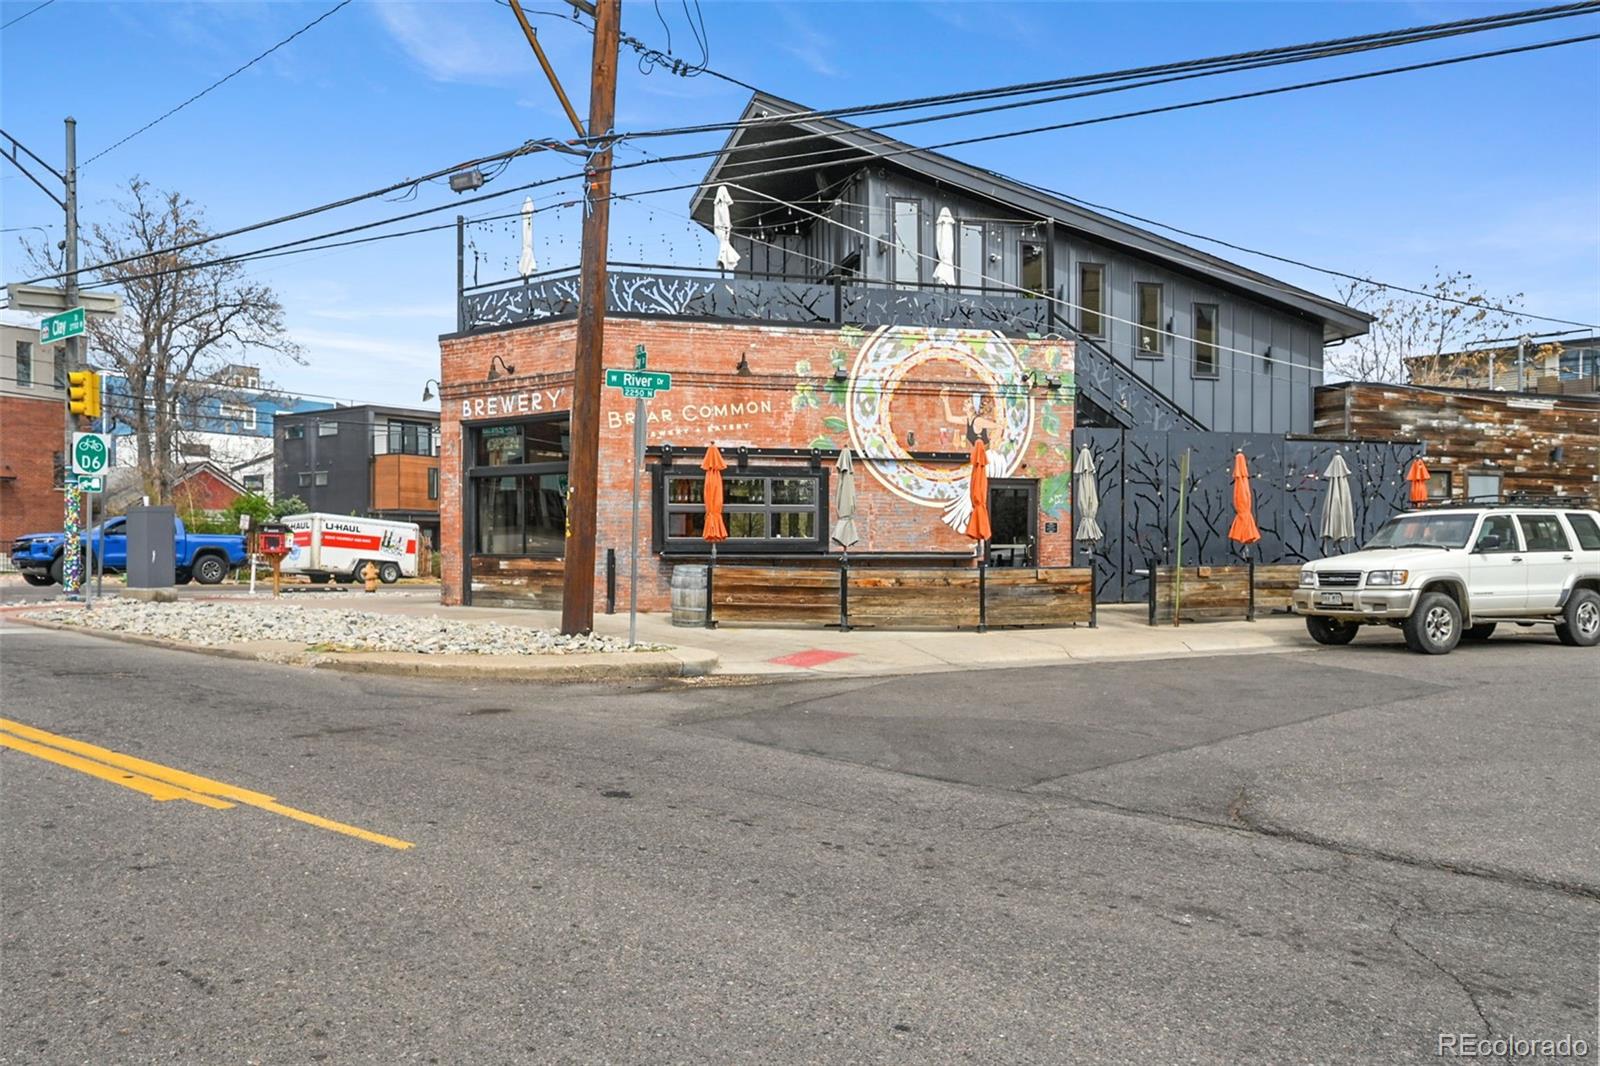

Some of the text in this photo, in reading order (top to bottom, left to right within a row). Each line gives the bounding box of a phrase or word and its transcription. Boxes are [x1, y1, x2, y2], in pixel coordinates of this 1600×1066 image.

[52, 319, 66, 336] Clay
[623, 373, 653, 387] River
[624, 389, 653, 397] 2250 N
[463, 389, 561, 417] BREWERY
[607, 401, 772, 429] BRAR COMMON
[707, 423, 750, 433] EATERY
[82, 455, 101, 469] D6
[325, 523, 361, 533] U-HAUL
